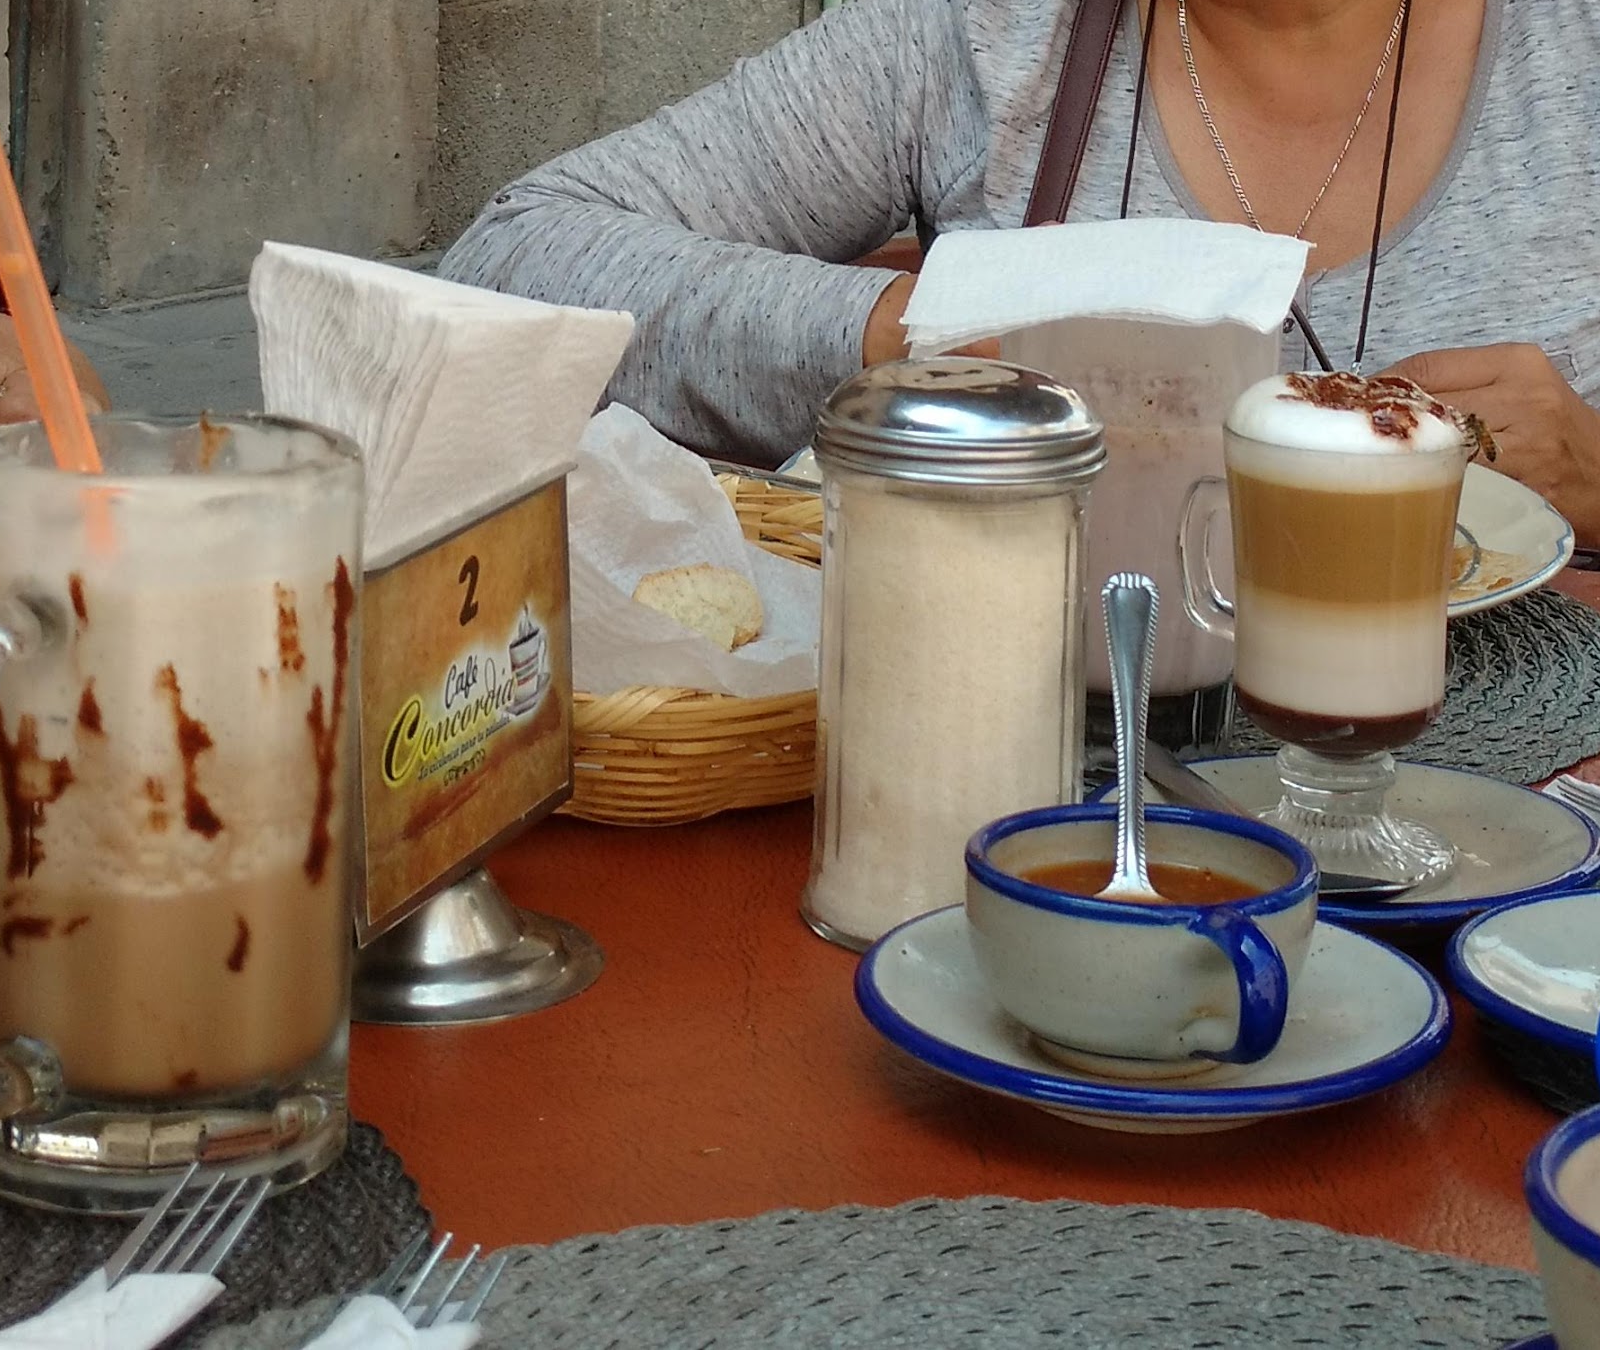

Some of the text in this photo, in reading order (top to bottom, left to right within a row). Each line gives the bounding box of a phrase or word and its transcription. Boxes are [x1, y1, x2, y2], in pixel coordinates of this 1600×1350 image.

[459, 554, 480, 627] 2
[444, 654, 478, 710] Café
[384, 657, 515, 781] Concordia
